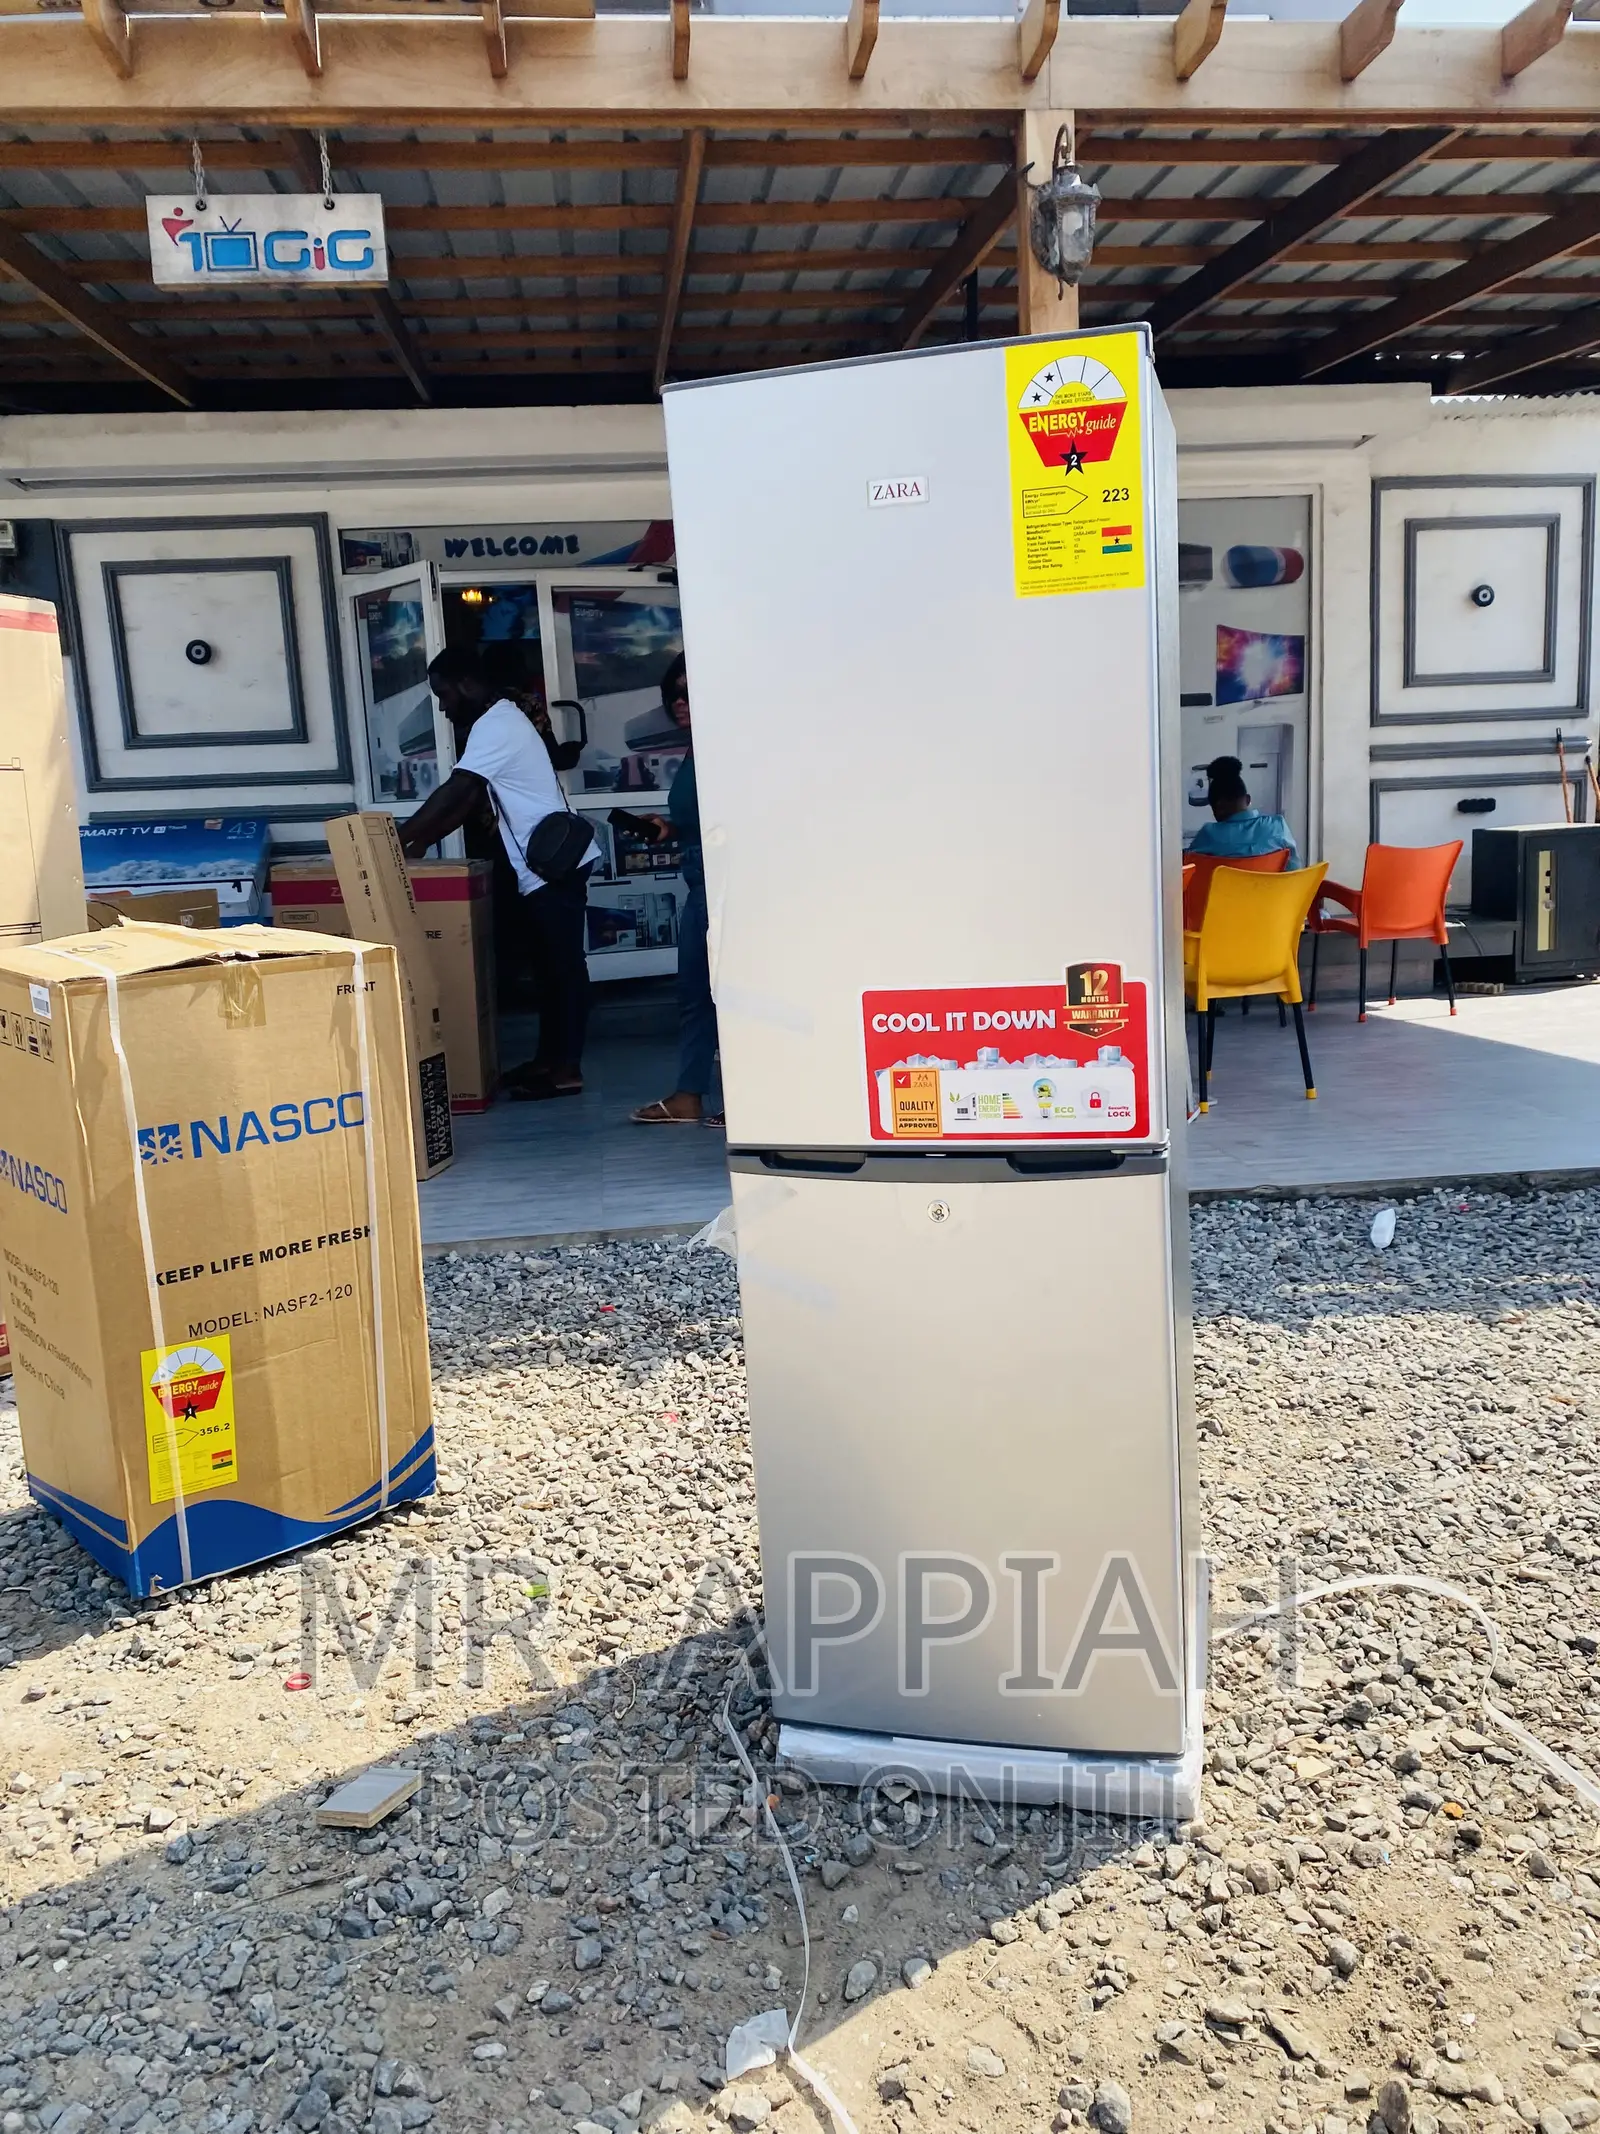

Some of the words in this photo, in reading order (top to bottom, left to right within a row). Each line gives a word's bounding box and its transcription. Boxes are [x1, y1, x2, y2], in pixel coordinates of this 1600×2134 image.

[1028, 410, 1087, 437] ENERGY
[1085, 413, 1117, 435] guide
[1070, 454, 1078, 466] 2
[872, 481, 922, 501] ZARA
[1102, 487, 1130, 503] 223
[443, 534, 581, 558] WELCOME
[79, 826, 128, 838] SMART
[131, 826, 151, 835] TV
[228, 821, 257, 835] 43
[385, 816, 397, 838] LG
[393, 844, 410, 889] Sound
[405, 890, 417, 916] Bar
[1079, 969, 1109, 996] 12
[1080, 995, 1110, 1004] MONTHS
[871, 1011, 941, 1034] COOL
[945, 1011, 967, 1032] IT
[973, 1009, 1056, 1032] DOWN
[1071, 1008, 1120, 1020] WARRANTY
[899, 1100, 935, 1111] QUALITY
[977, 1094, 1001, 1105] HOME
[1054, 1106, 1075, 1114] ECO
[190, 1091, 367, 1159] NASCO
[9, 1154, 68, 1215] NASCO
[210, 1253, 255, 1275] LIFE
[259, 1238, 313, 1264] MORE
[188, 1311, 259, 1338] MODEL:
[263, 1283, 354, 1319] NASF2-120
[197, 1379, 219, 1396] guide
[187, 1407, 193, 1415] 1
[199, 1422, 231, 1437] 356.2
